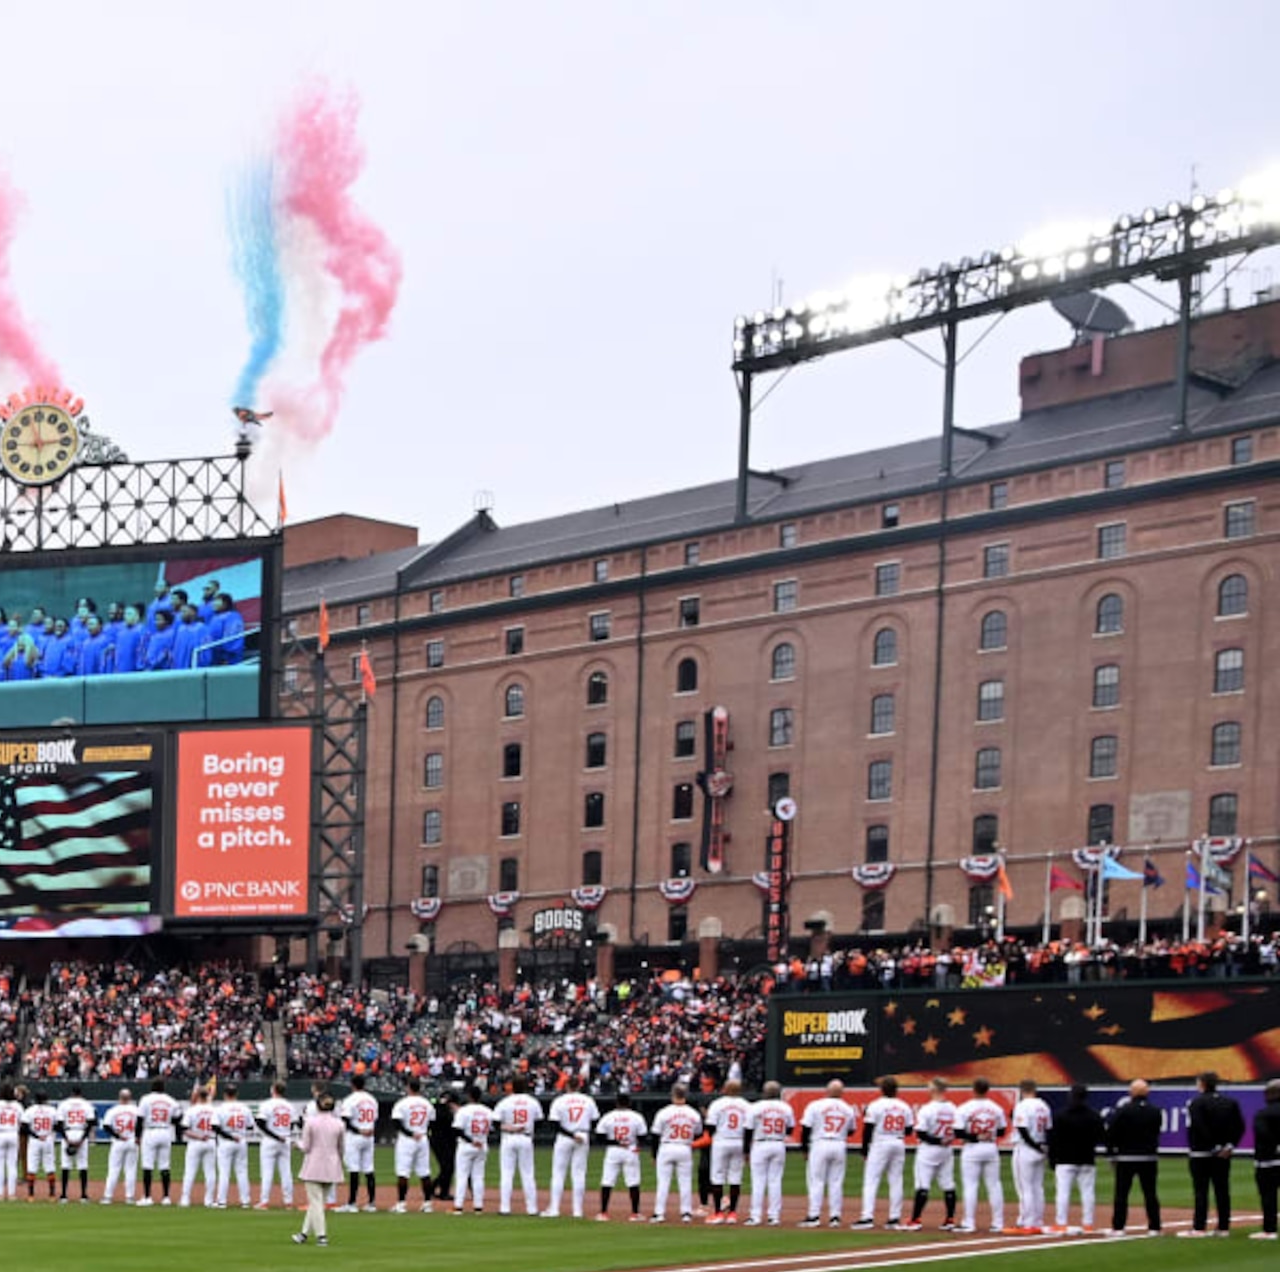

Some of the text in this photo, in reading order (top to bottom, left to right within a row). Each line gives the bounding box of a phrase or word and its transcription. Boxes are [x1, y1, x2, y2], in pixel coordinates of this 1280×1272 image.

[9, 764, 57, 774] SPORTS
[203, 751, 285, 777] Boring
[208, 781, 279, 799] never
[200, 801, 285, 823] misses
[197, 825, 291, 852] a pitch.
[204, 880, 301, 898] PNC BANK
[784, 1009, 867, 1036] SUPERBOOK
[801, 1034, 846, 1044] SPORTS
[227, 1115, 244, 1128] 45
[358, 1109, 374, 1122] 30
[410, 1112, 427, 1126] 27
[513, 1110, 527, 1124] 19
[568, 1107, 583, 1122] 17
[729, 1114, 738, 1129] 9
[115, 1120, 135, 1133] 54
[763, 1118, 785, 1133] 59
[824, 1116, 845, 1132] 57
[884, 1115, 906, 1131] 89
[971, 1119, 996, 1135] 62
[670, 1124, 692, 1139] 36
